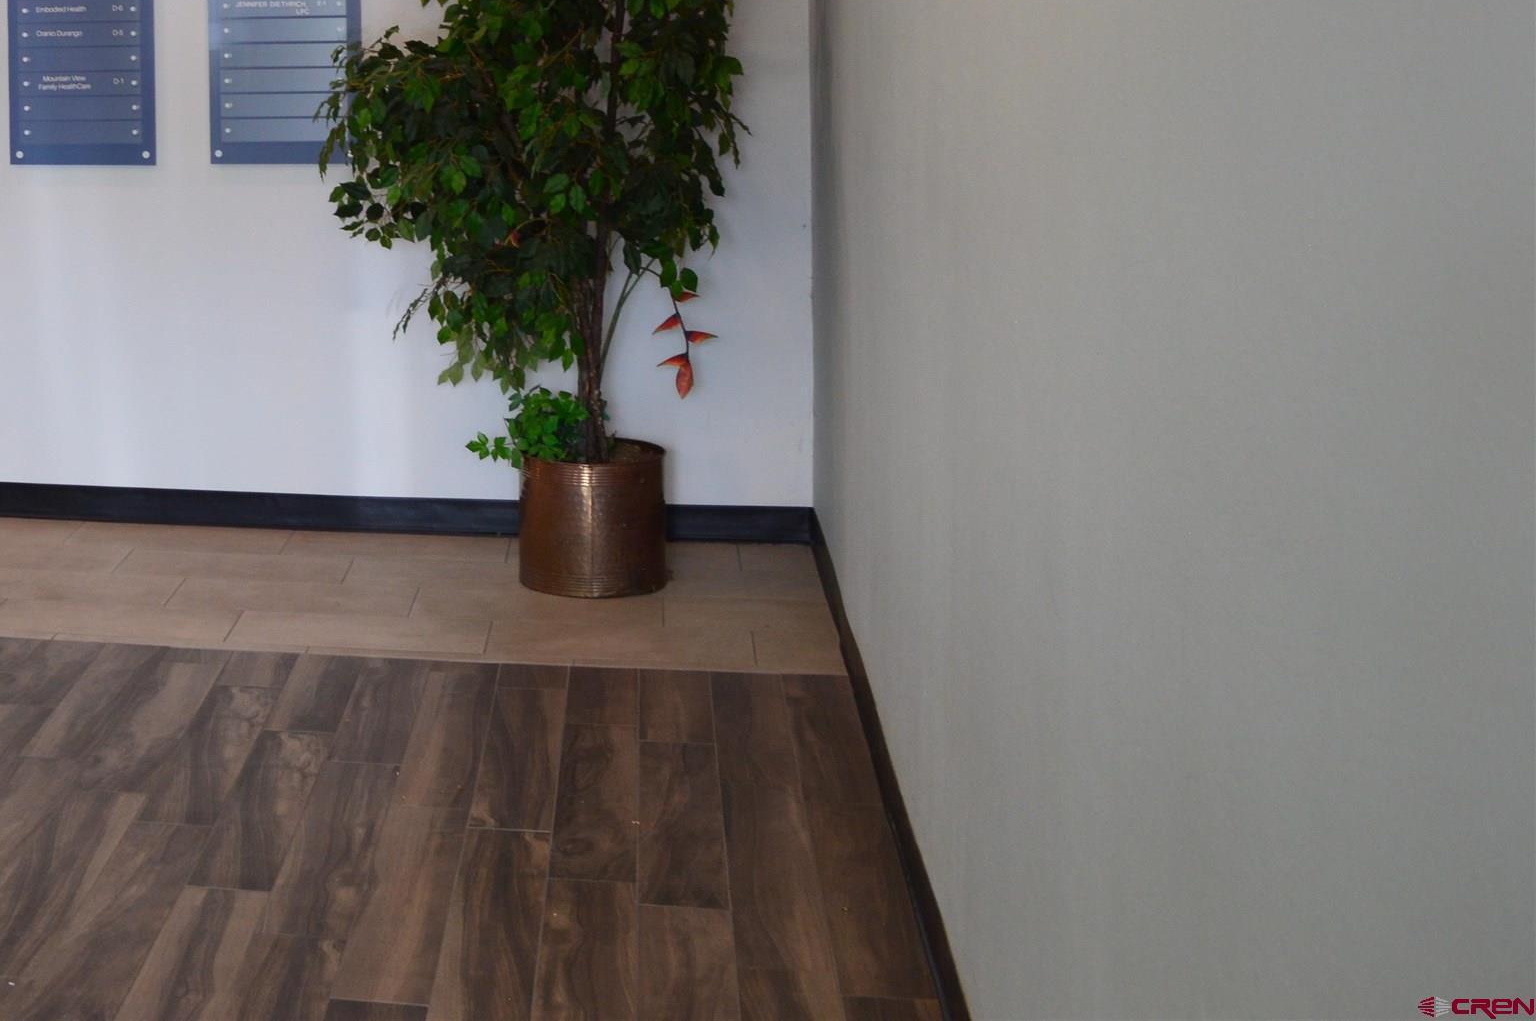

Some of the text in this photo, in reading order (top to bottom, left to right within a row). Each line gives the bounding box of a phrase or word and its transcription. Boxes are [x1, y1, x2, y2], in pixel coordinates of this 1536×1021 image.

[66, 5, 87, 13] Health
[56, 29, 83, 38] Durango
[38, 83, 58, 91] Family
